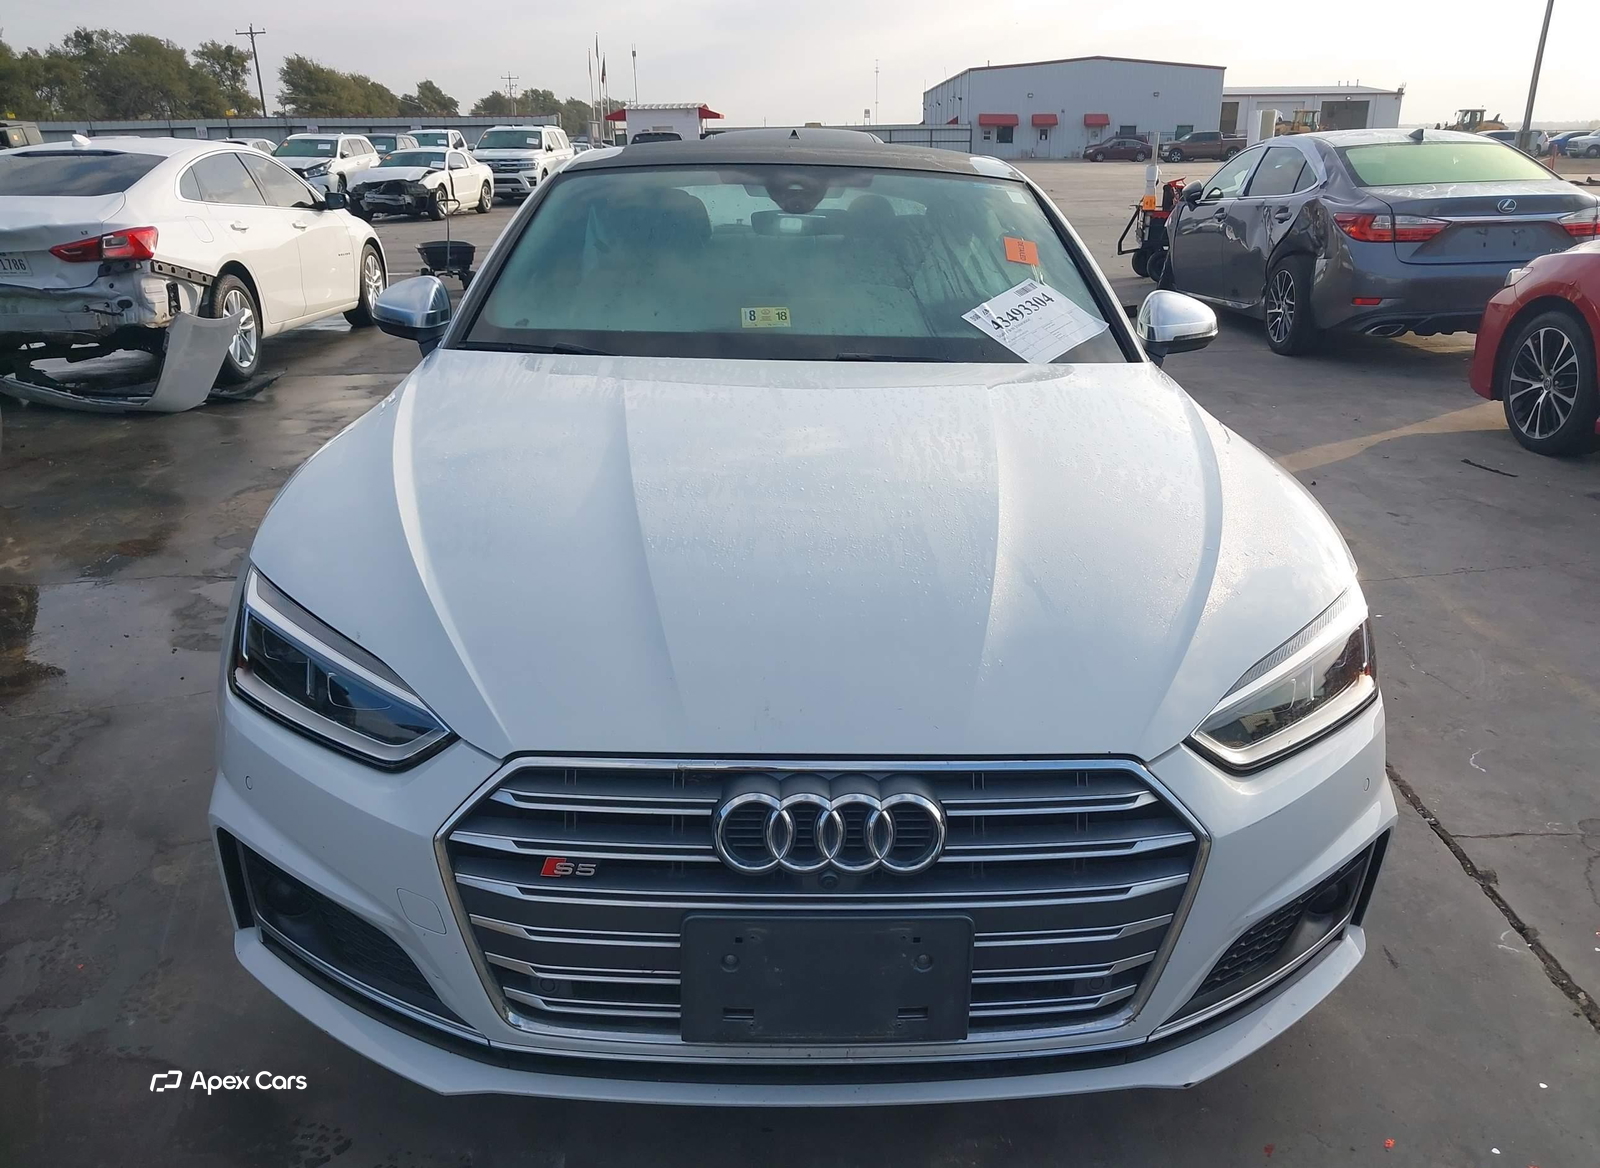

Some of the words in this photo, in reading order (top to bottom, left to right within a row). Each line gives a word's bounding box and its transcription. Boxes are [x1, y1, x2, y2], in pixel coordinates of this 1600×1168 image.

[749, 310, 756, 321] 8
[775, 311, 787, 321] 18
[991, 292, 1055, 331] 43493304
[553, 861, 597, 877] S5
